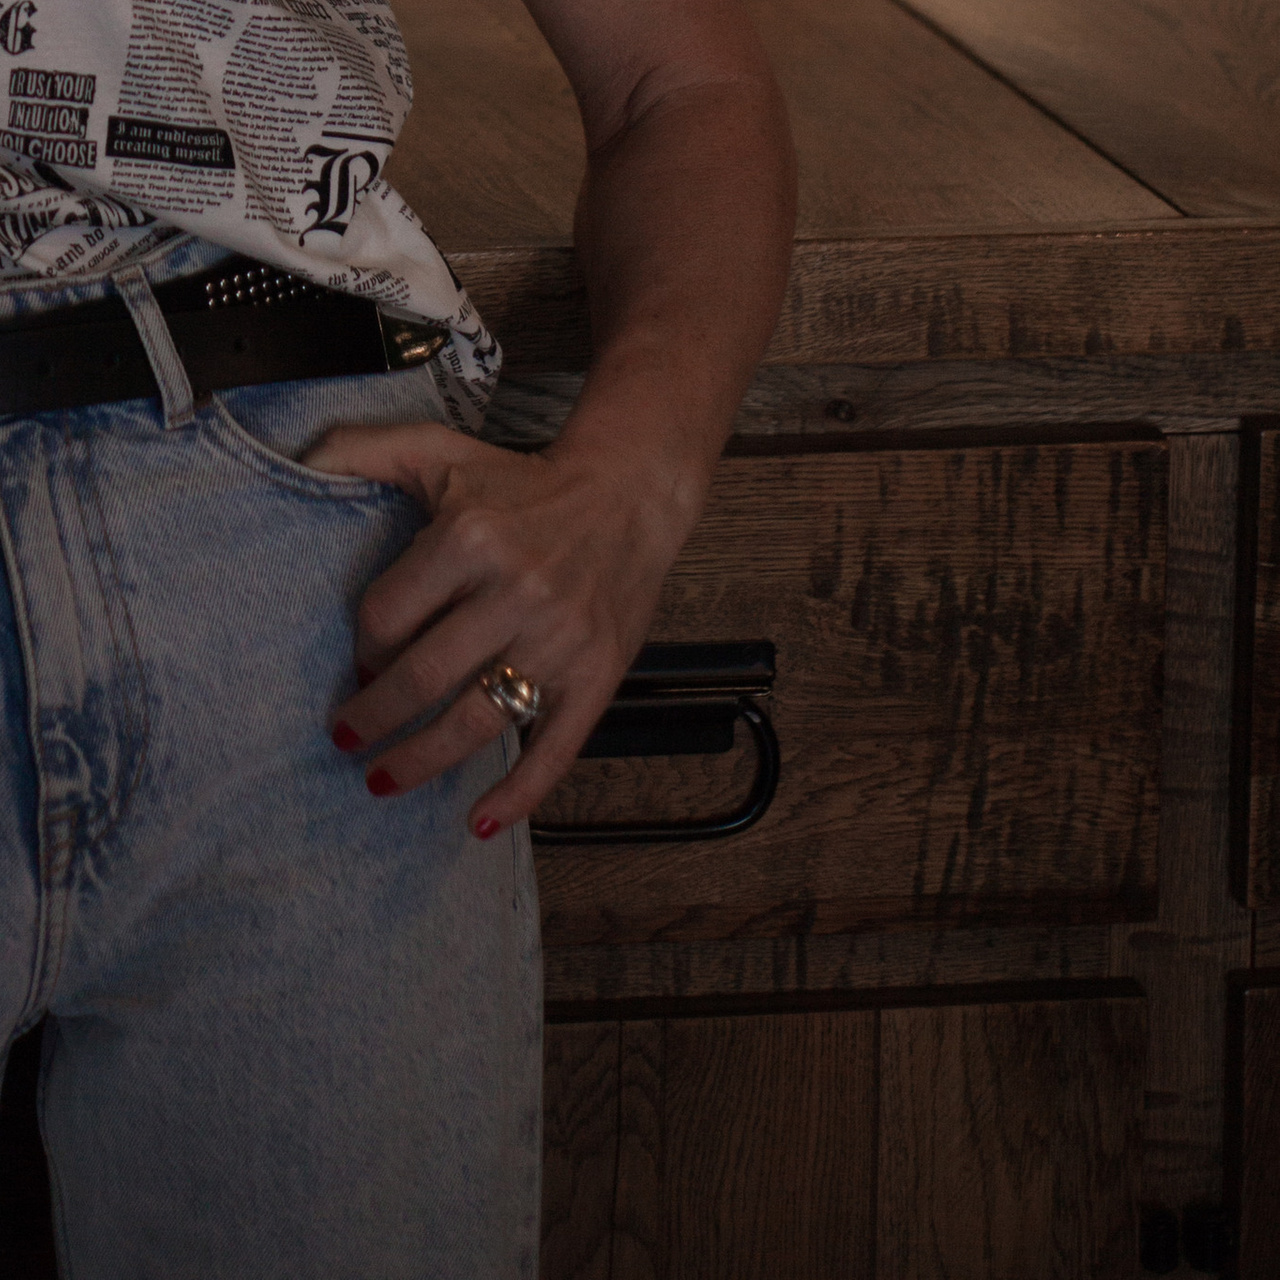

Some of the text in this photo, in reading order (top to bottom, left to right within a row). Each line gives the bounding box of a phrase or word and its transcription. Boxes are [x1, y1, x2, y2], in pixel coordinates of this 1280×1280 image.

[53, 72, 95, 102] YOUR
[116, 122, 126, 135] I
[131, 126, 151, 138] am
[28, 136, 97, 168] CHOOSE
[114, 141, 225, 162] creating myself.
